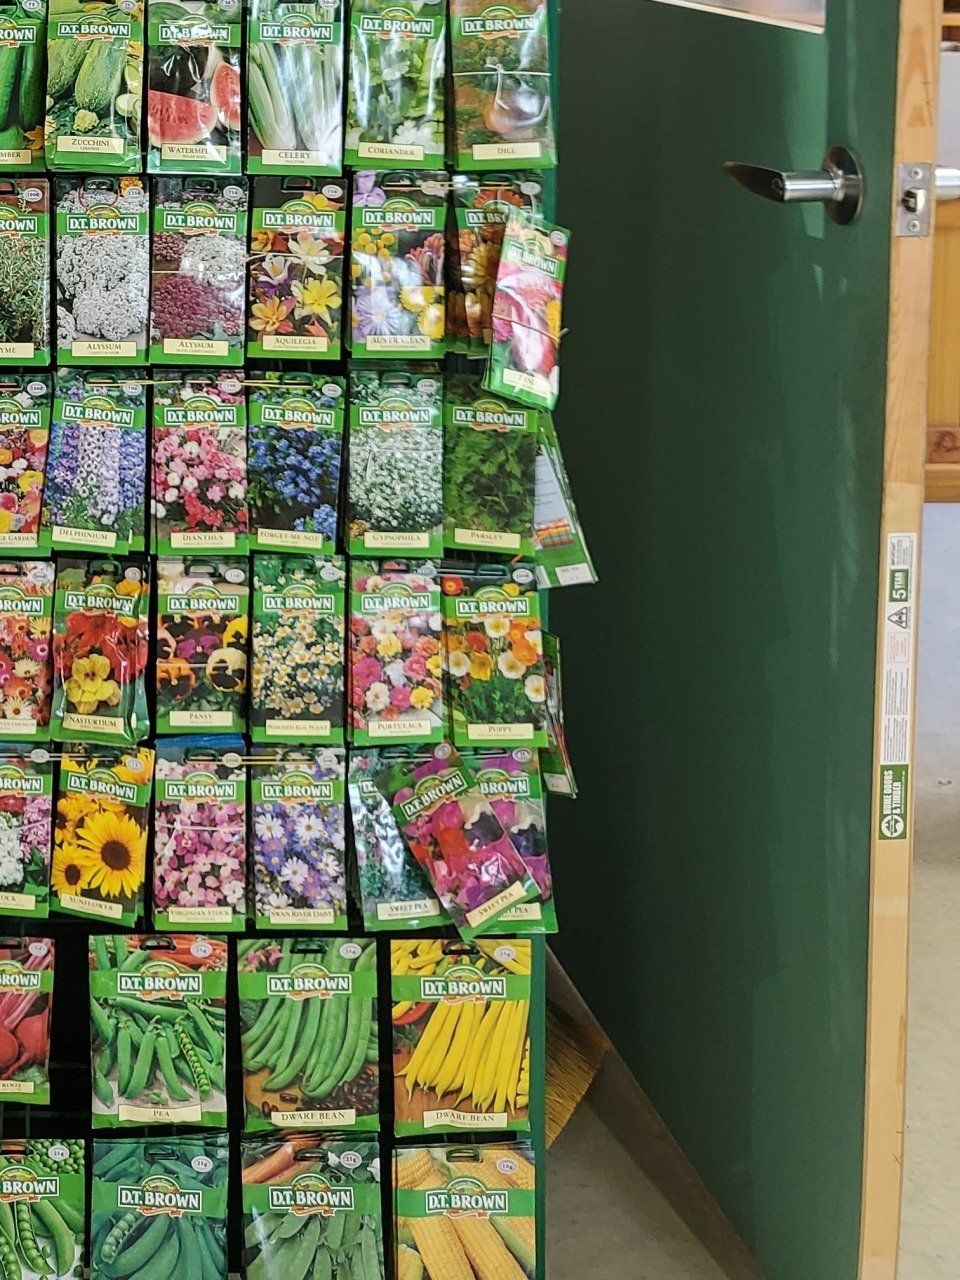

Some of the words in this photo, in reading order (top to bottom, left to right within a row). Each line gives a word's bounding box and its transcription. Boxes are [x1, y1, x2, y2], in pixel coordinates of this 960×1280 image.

[72, 138, 109, 148] ZUCCHINI
[278, 151, 311, 159] CELERY
[368, 146, 415, 156] CORIANDER
[86, 342, 122, 351] ALYSSUM
[892, 588, 907, 599] 5
[281, 1112, 316, 1121] DWARF
[319, 1112, 345, 1120] BEAN
[2, 1180, 56, 1193] BROWN
[295, 1191, 351, 1205] BROWN
[451, 1194, 505, 1209] BROWN
